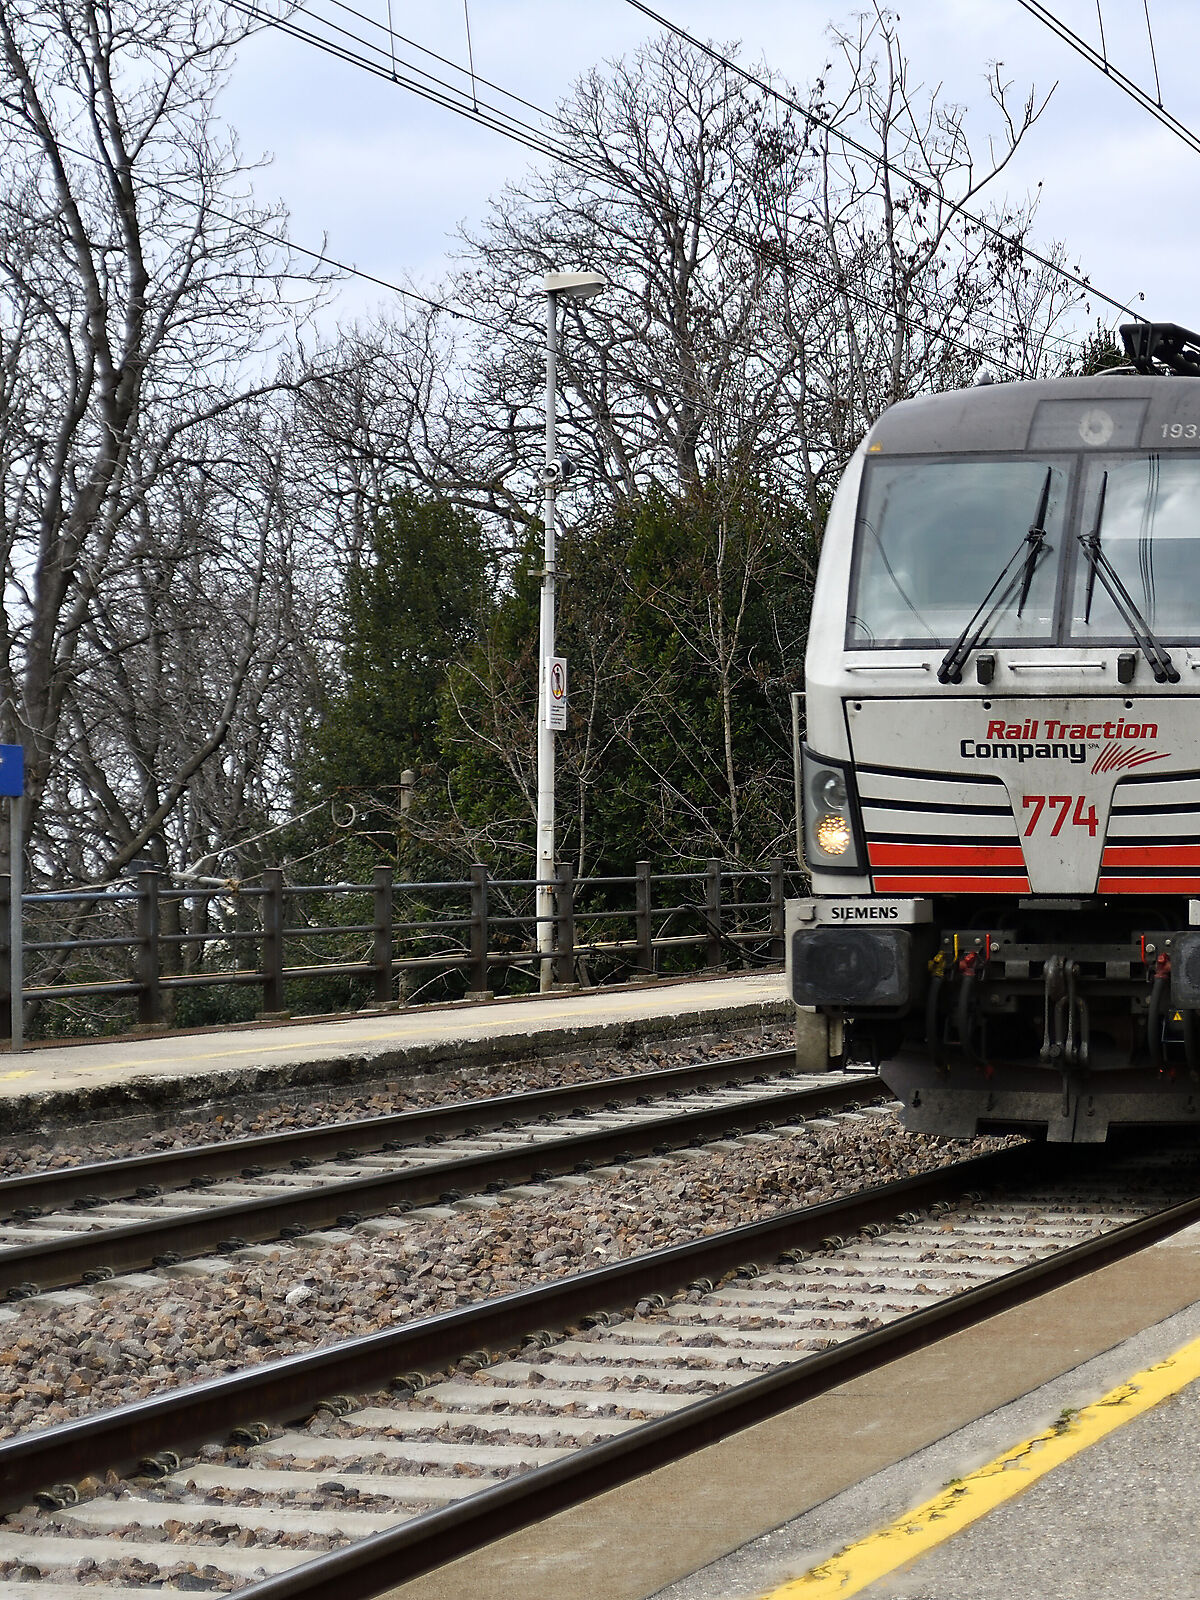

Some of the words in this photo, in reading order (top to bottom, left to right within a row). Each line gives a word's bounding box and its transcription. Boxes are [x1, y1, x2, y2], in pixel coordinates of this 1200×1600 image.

[986, 719, 1039, 740] Rail
[1044, 717, 1158, 740] Traction
[960, 739, 1087, 763] Company
[1022, 795, 1099, 837] 774
[831, 906, 899, 920] SIEMENS
